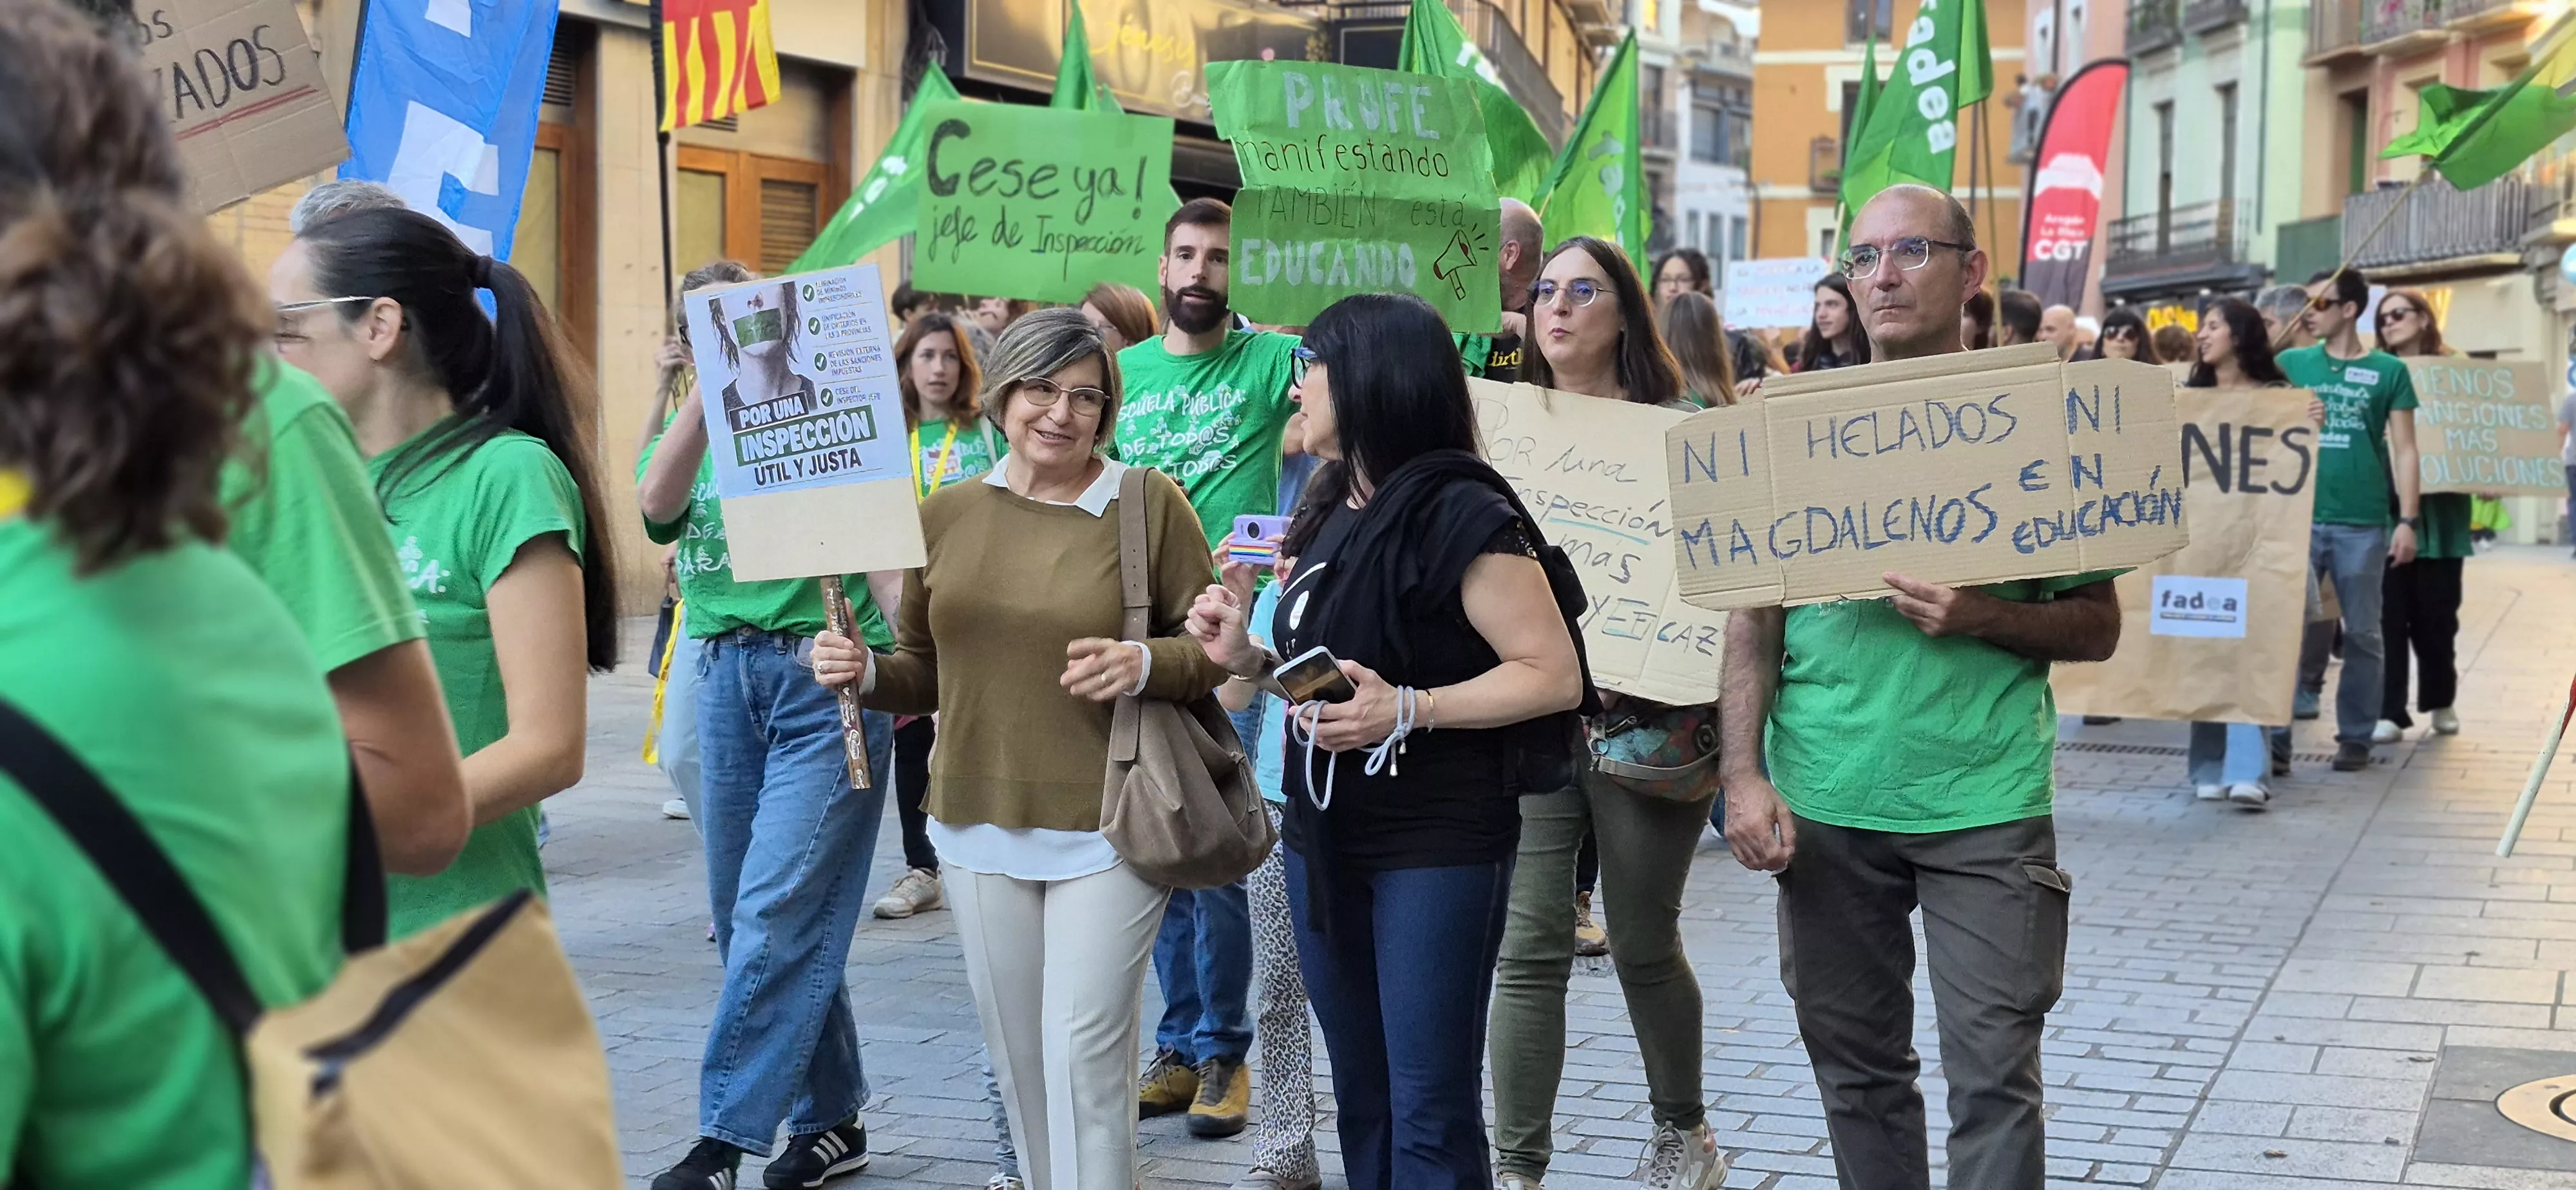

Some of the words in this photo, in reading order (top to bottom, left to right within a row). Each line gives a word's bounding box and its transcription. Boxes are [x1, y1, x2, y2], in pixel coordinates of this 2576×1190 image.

[155, 24, 287, 120] ADOS
[1906, 0, 1956, 154] adea
[1283, 71, 1440, 140] PROFE
[927, 118, 1059, 200] Cese
[1235, 135, 1448, 177] manifestando
[928, 205, 978, 264] jefe
[992, 205, 1023, 249] de
[1030, 215, 1146, 282] Inspección
[1239, 238, 1416, 288] EDUCANDO
[2034, 239, 2088, 260] CGT
[739, 404, 772, 429] POR
[773, 395, 804, 420] UNA
[1117, 390, 1175, 422] SCUELA
[1182, 389, 1247, 415] PÚBLICA:
[741, 410, 871, 462] INSPECCIÓN
[1122, 437, 1146, 459] DE
[1157, 426, 1229, 451] TOD@S
[1684, 429, 1749, 484] NI
[1807, 393, 2018, 460] HELADOS
[2067, 385, 2121, 435] NI
[2445, 426, 2497, 453] MÁS
[754, 461, 791, 486] ÚTIL
[793, 458, 804, 478] Y
[809, 448, 862, 476] JUSTA
[1503, 476, 1673, 537] nspección
[1681, 483, 1998, 571] MAGDALENOS
[2011, 465, 2182, 554] EDUCACIÓN
[2161, 590, 2238, 612] fadea
